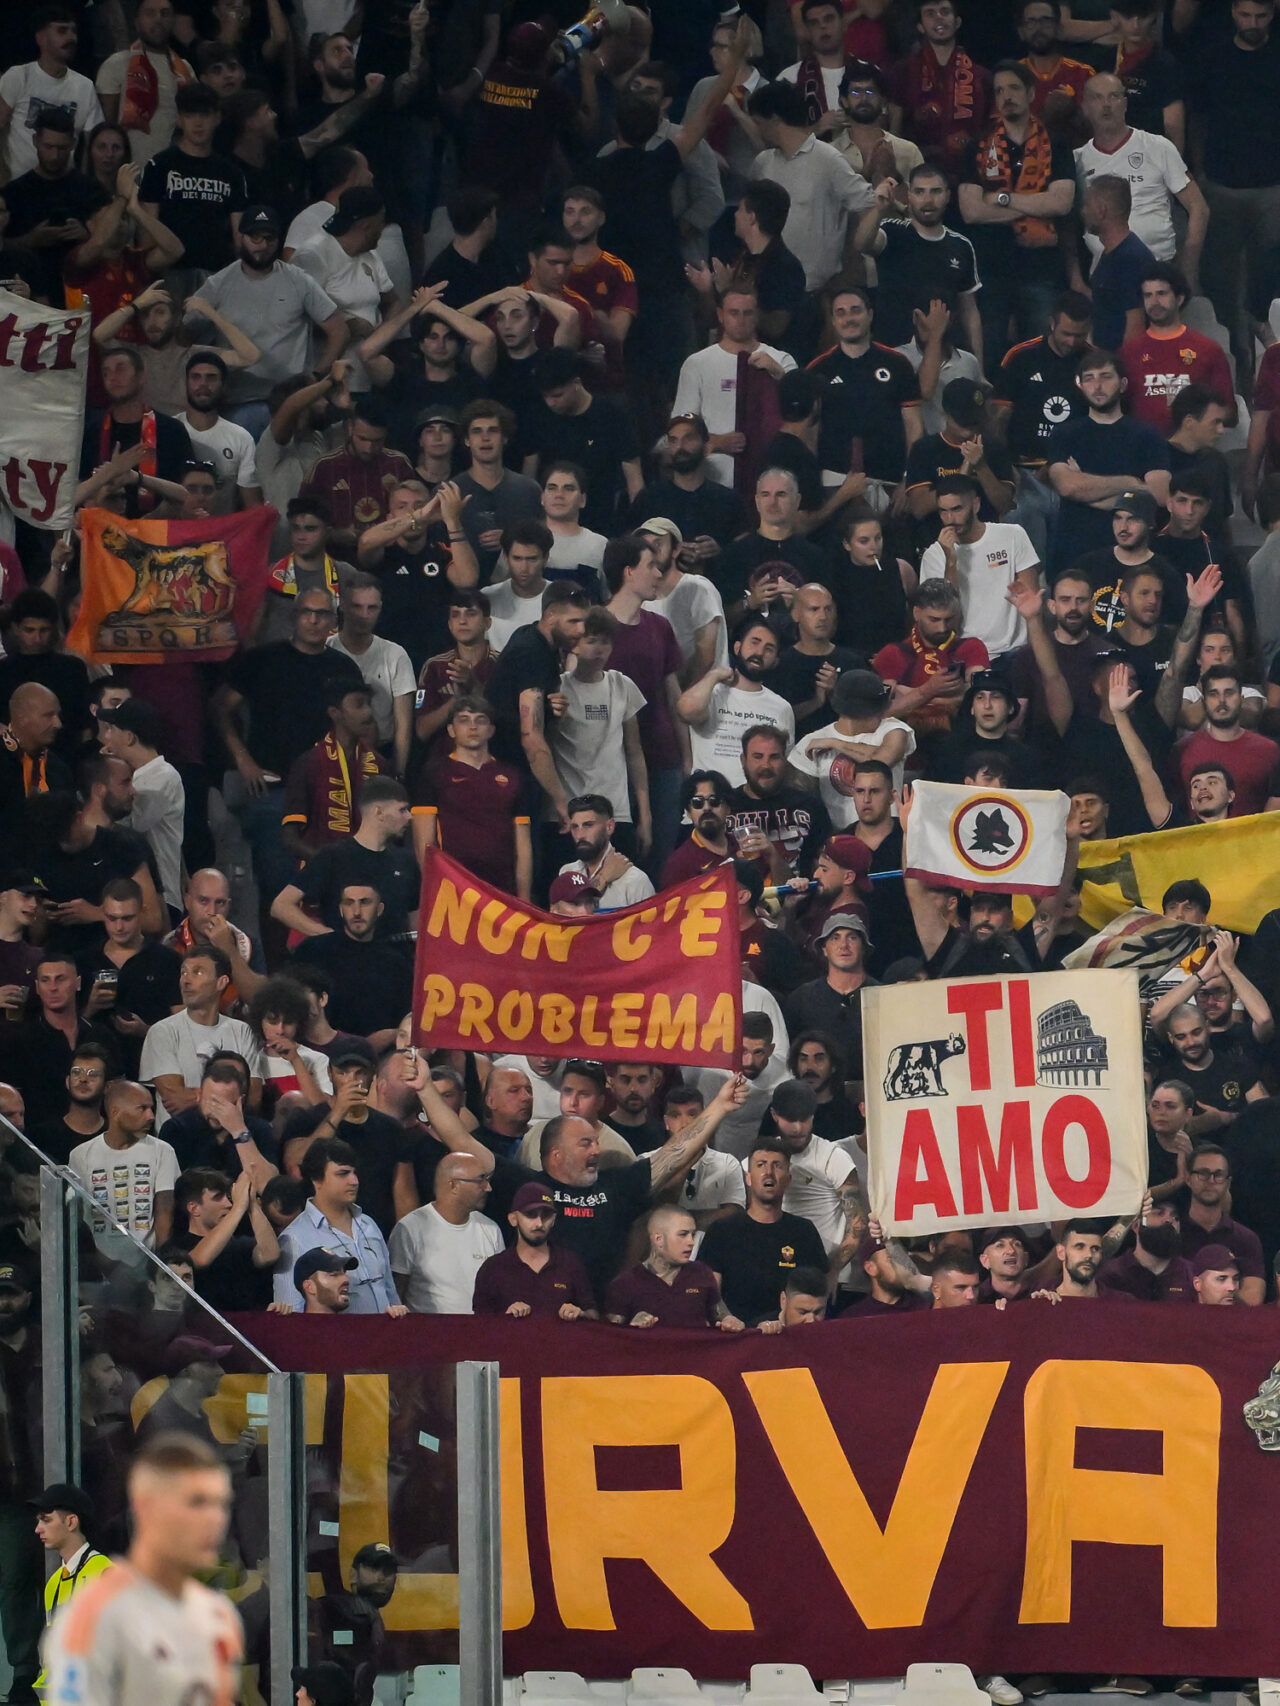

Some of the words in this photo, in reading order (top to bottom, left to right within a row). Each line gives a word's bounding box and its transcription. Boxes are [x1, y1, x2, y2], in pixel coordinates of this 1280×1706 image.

[175, 176, 231, 196] BOXEUR
[1144, 373, 1191, 386] INA
[3, 457, 68, 522] ty
[986, 549, 1008, 563] 1986
[114, 626, 212, 648] SPQR
[427, 878, 584, 962] NUN
[419, 974, 736, 1052] PROBLEMA
[946, 979, 1036, 1092] TI
[894, 1094, 1112, 1222] AMO
